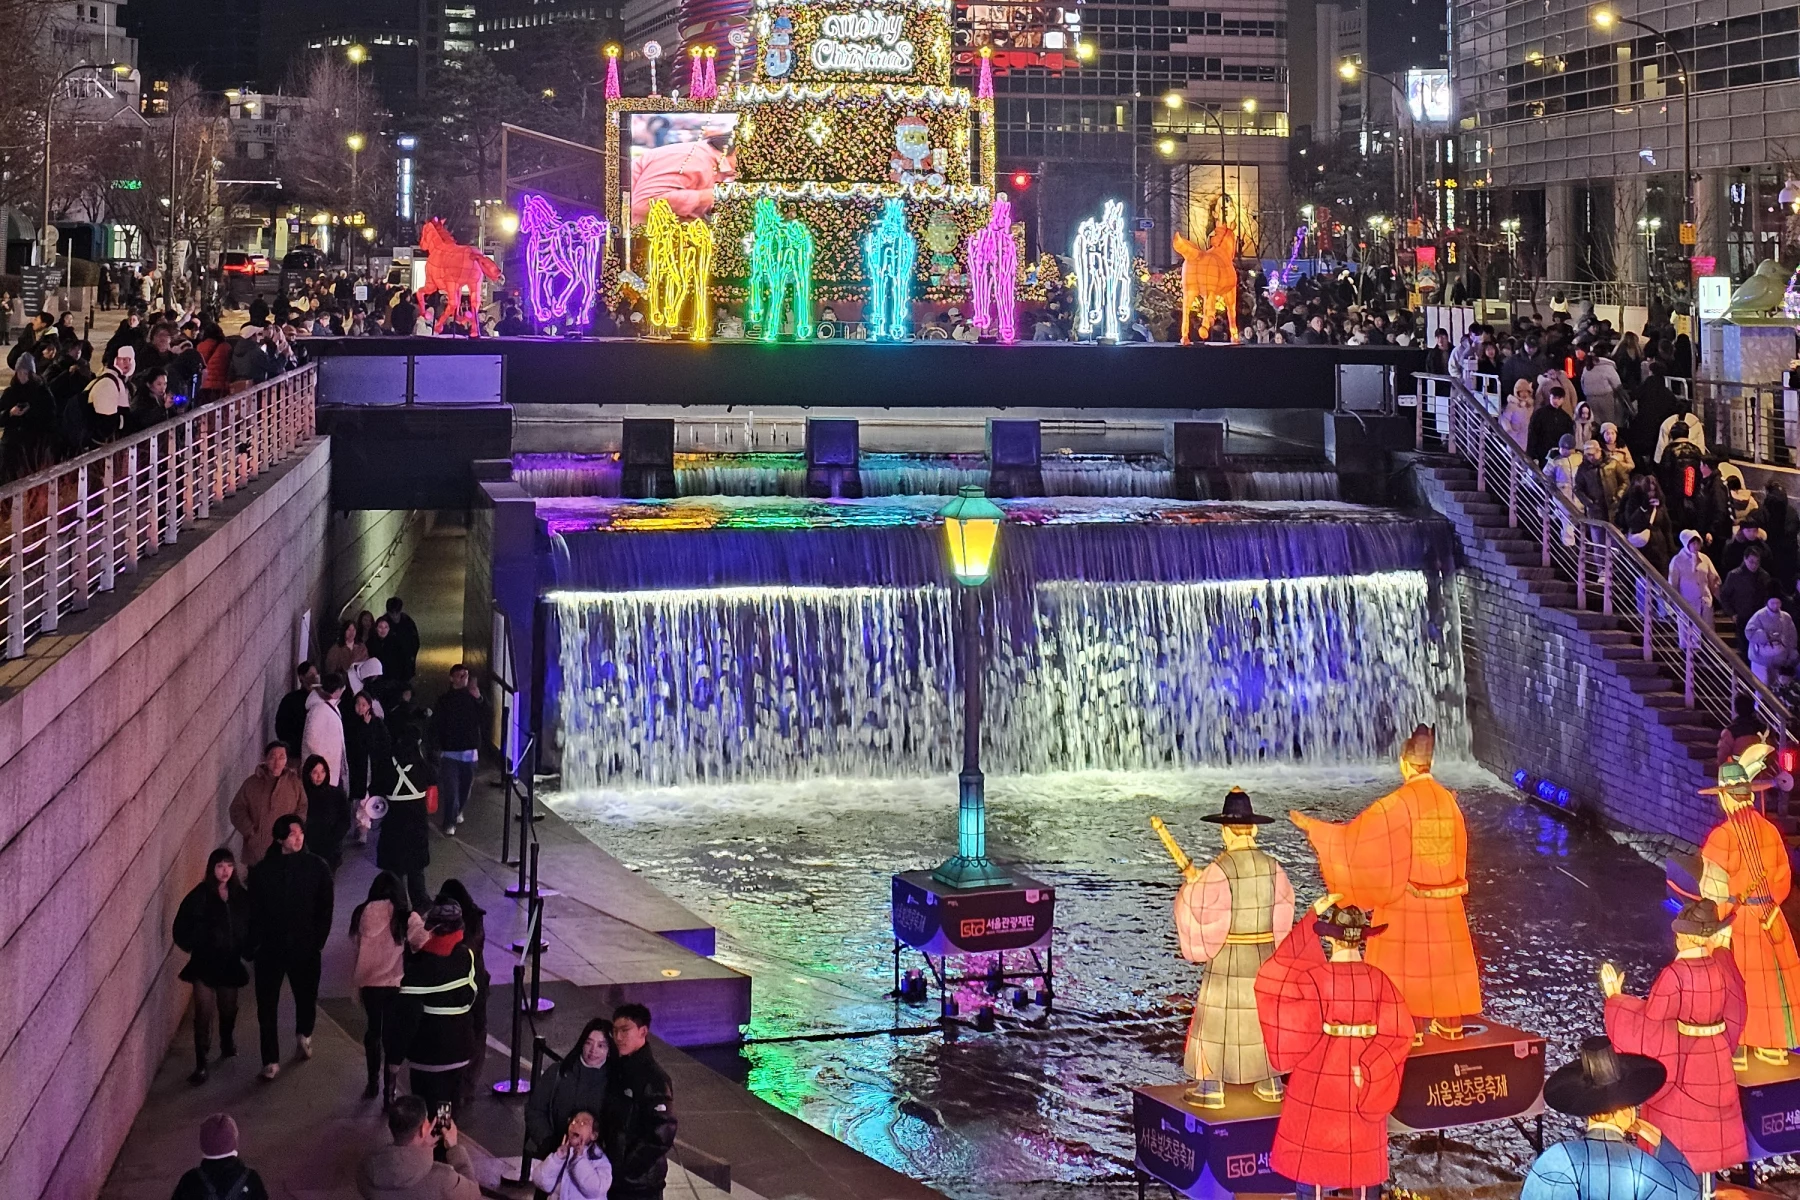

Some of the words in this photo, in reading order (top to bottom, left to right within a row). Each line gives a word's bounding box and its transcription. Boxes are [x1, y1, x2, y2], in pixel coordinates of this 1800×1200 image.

[824, 10, 904, 46] Merry
[812, 39, 915, 71] Christmas
[986, 915, 1035, 930] 서울관광재단
[1427, 1074, 1508, 1107] 서울빛초롱축제
[1140, 1128, 1195, 1172] 서울빛초롱축제
